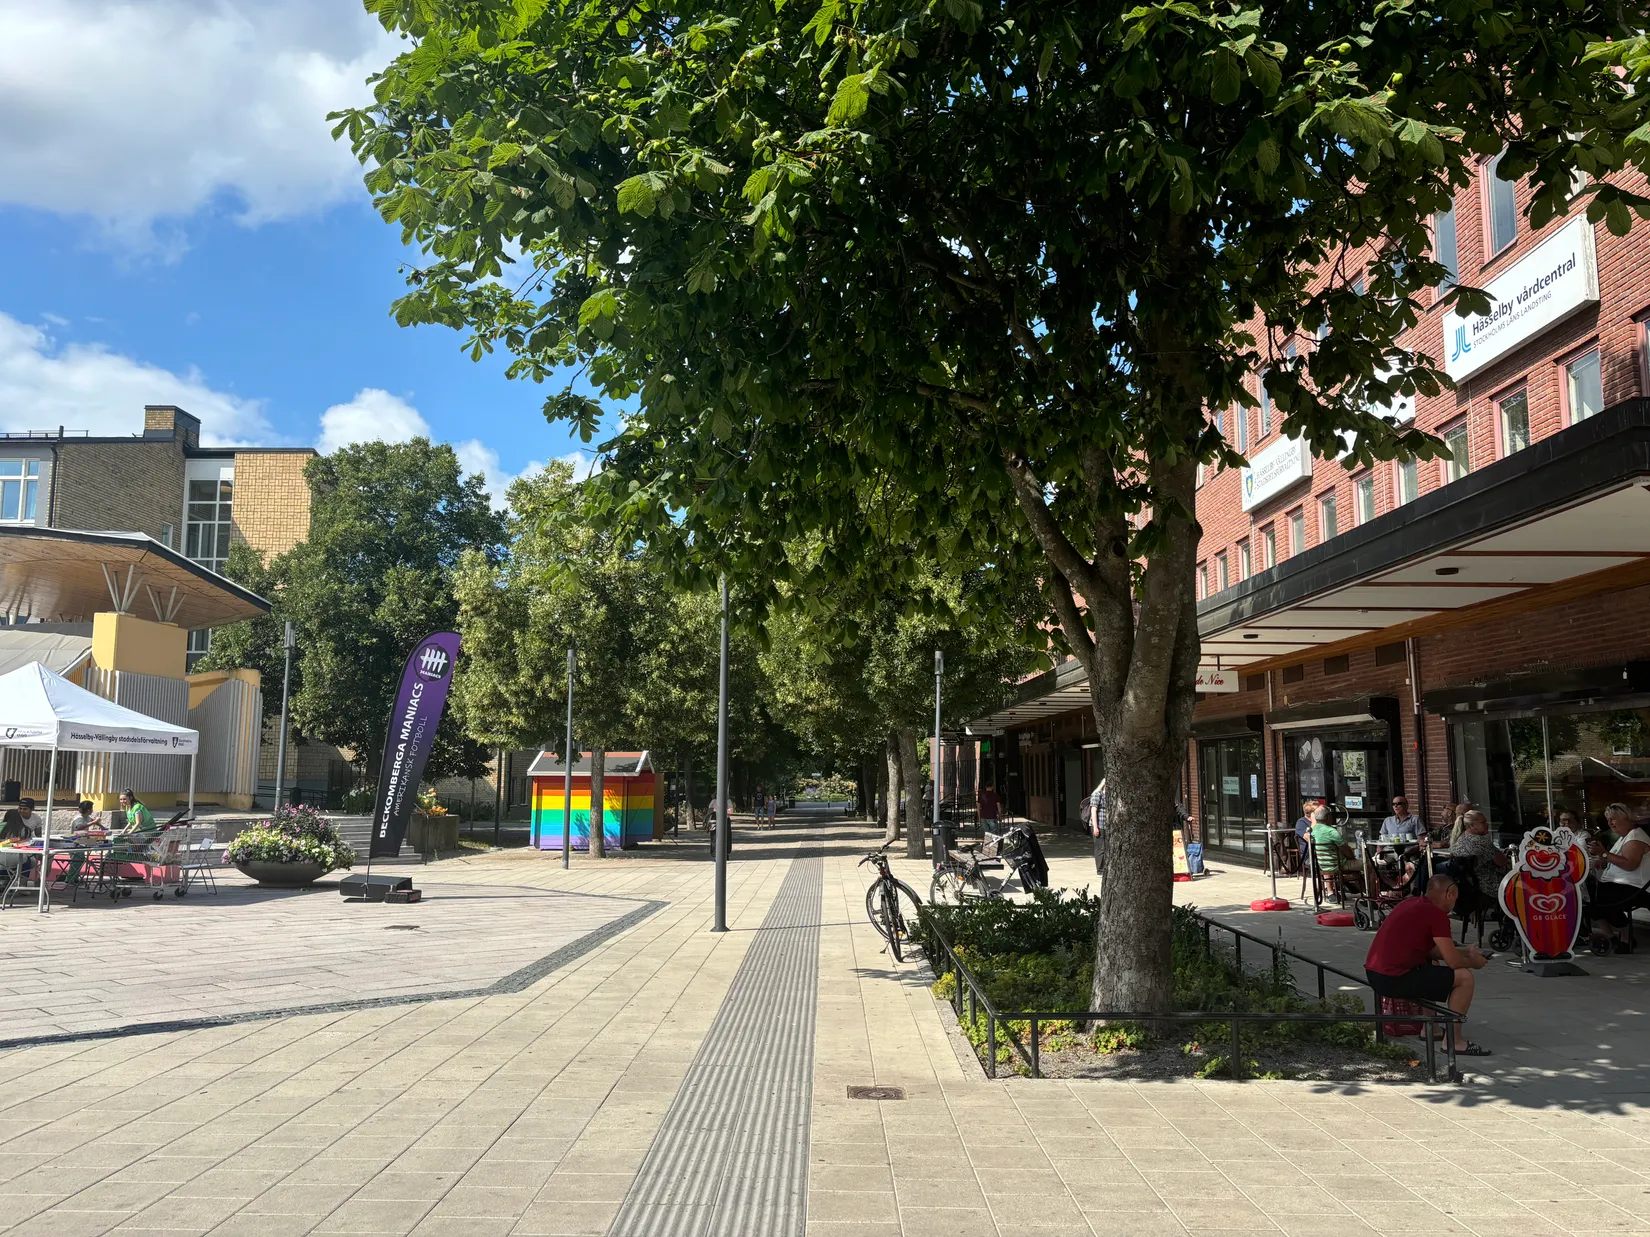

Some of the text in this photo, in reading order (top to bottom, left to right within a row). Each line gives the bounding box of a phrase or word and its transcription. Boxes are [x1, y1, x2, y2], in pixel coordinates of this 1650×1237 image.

[1472, 252, 1576, 336] Hässelby vårdcentral
[1473, 322, 1506, 348] STOCKHOLMS
[1521, 290, 1552, 316] LANDSTING
[70, 732, 118, 743] Hässelby-Vällingby
[118, 736, 168, 746] stadsdelsförvaltning
[379, 682, 424, 838] BECKOMBERGA MANIACS
[394, 716, 428, 817] AMERIKANSK FOTBOLL
